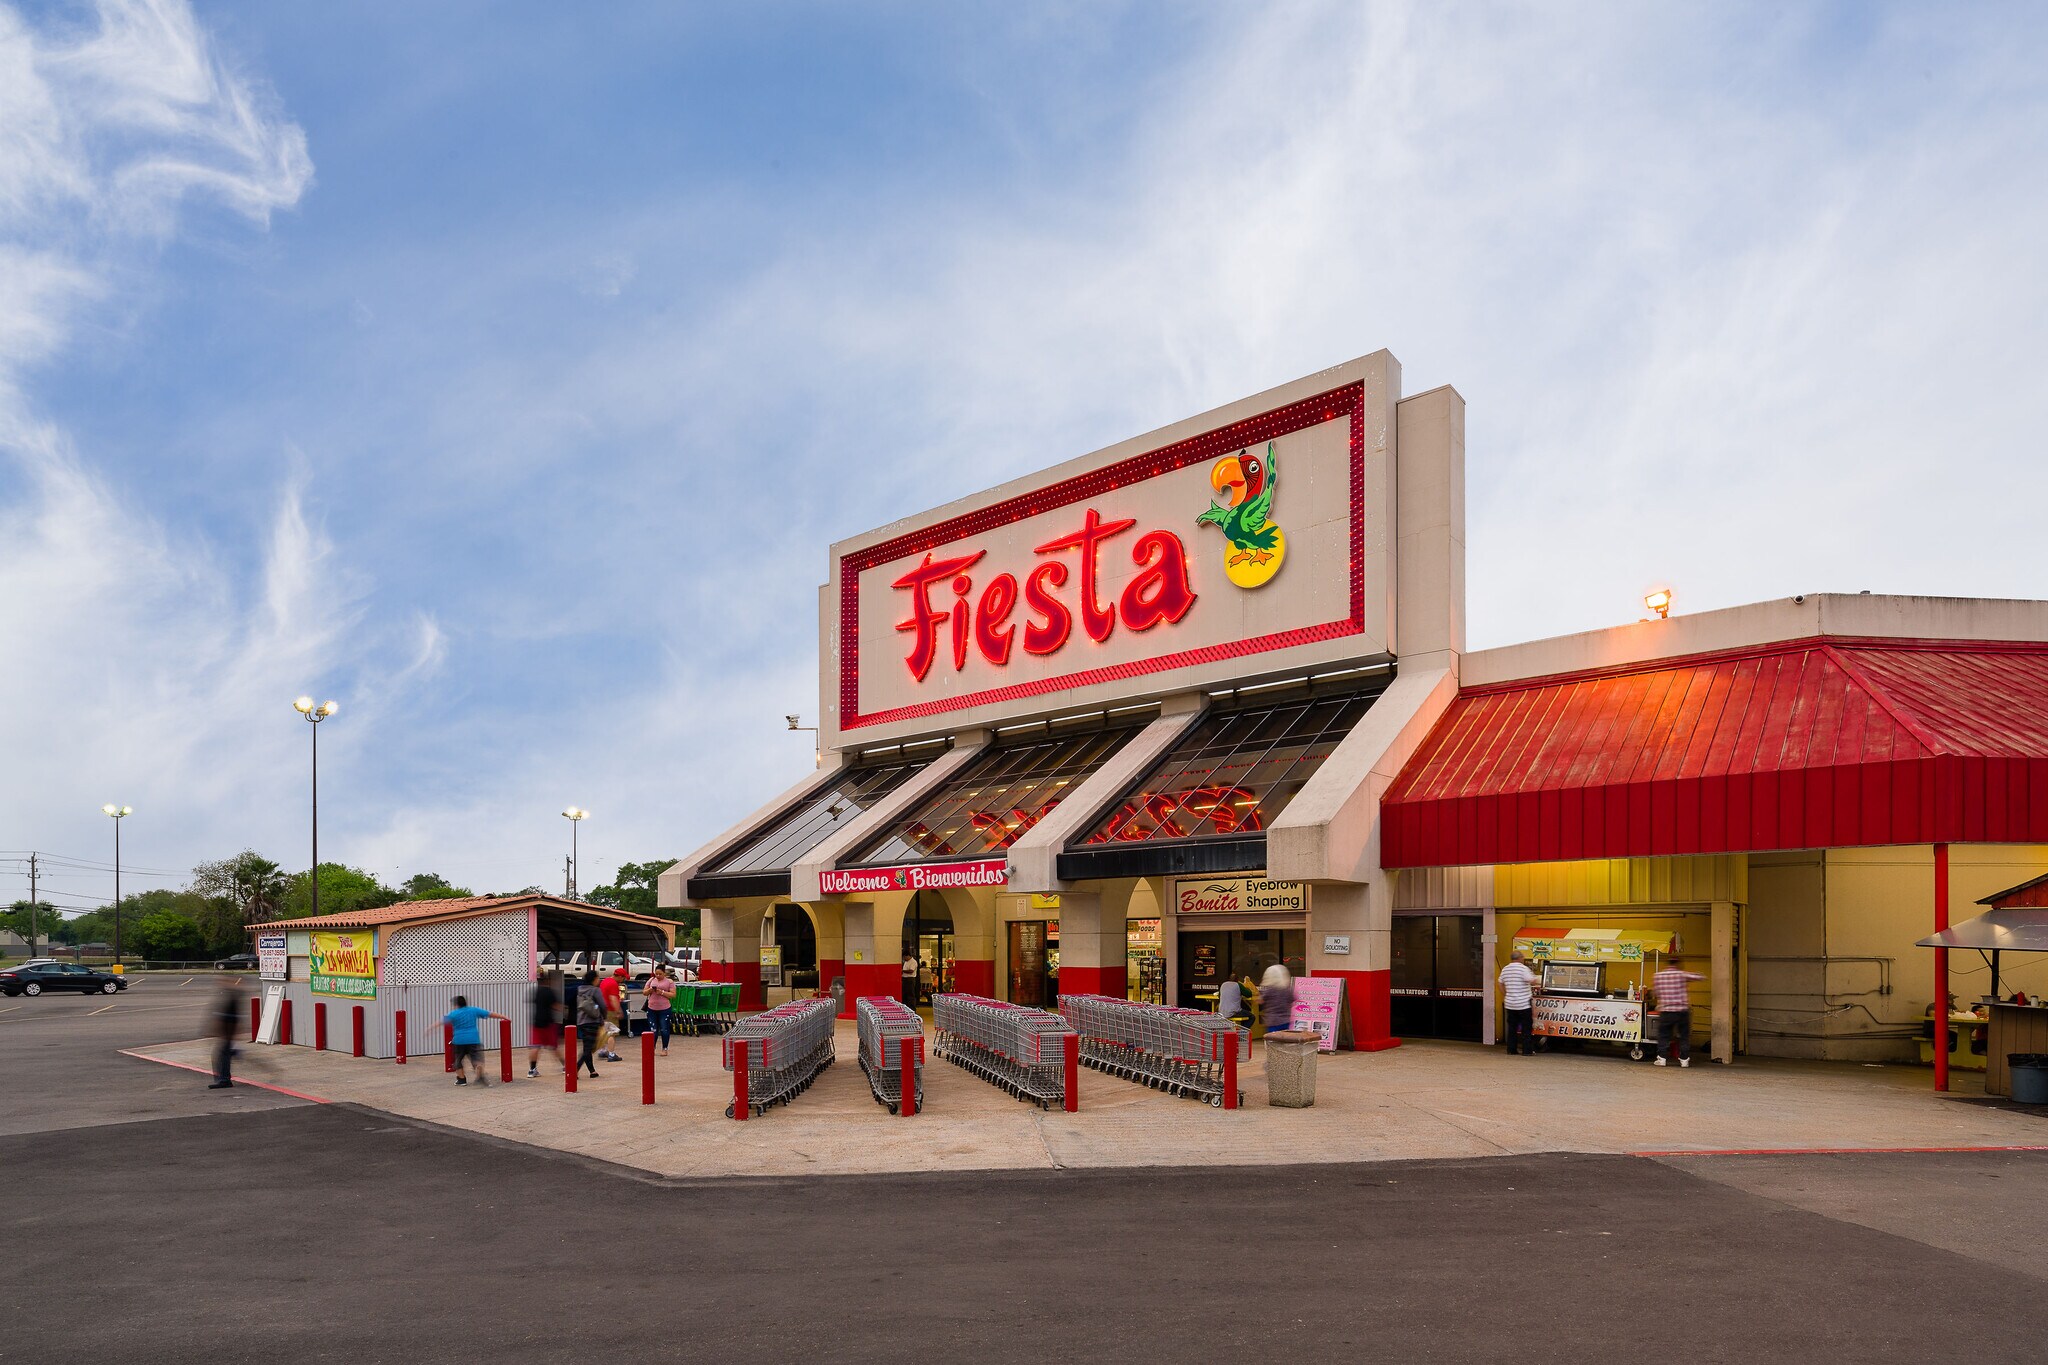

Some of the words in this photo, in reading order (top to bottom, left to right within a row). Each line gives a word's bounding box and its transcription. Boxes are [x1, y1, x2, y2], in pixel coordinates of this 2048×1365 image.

[890, 507, 1198, 683] Fiesta
[821, 872, 890, 892] Welcome
[909, 864, 1004, 888] Bienvenidos
[1246, 880, 1299, 893] Eyebrow
[1180, 890, 1240, 911] Bonita
[1246, 895, 1300, 909] Shaping
[325, 950, 337, 972] LA
[336, 950, 369, 973] PARILLA
[313, 976, 330, 991] FAJITAS
[1535, 999, 1560, 1008] DOGS
[1561, 999, 1568, 1008] Y
[1537, 1012, 1617, 1025] HAMBURGUESAS
[1558, 1026, 1569, 1035] EL
[1572, 1027, 1625, 1039] PAPIRRINN
